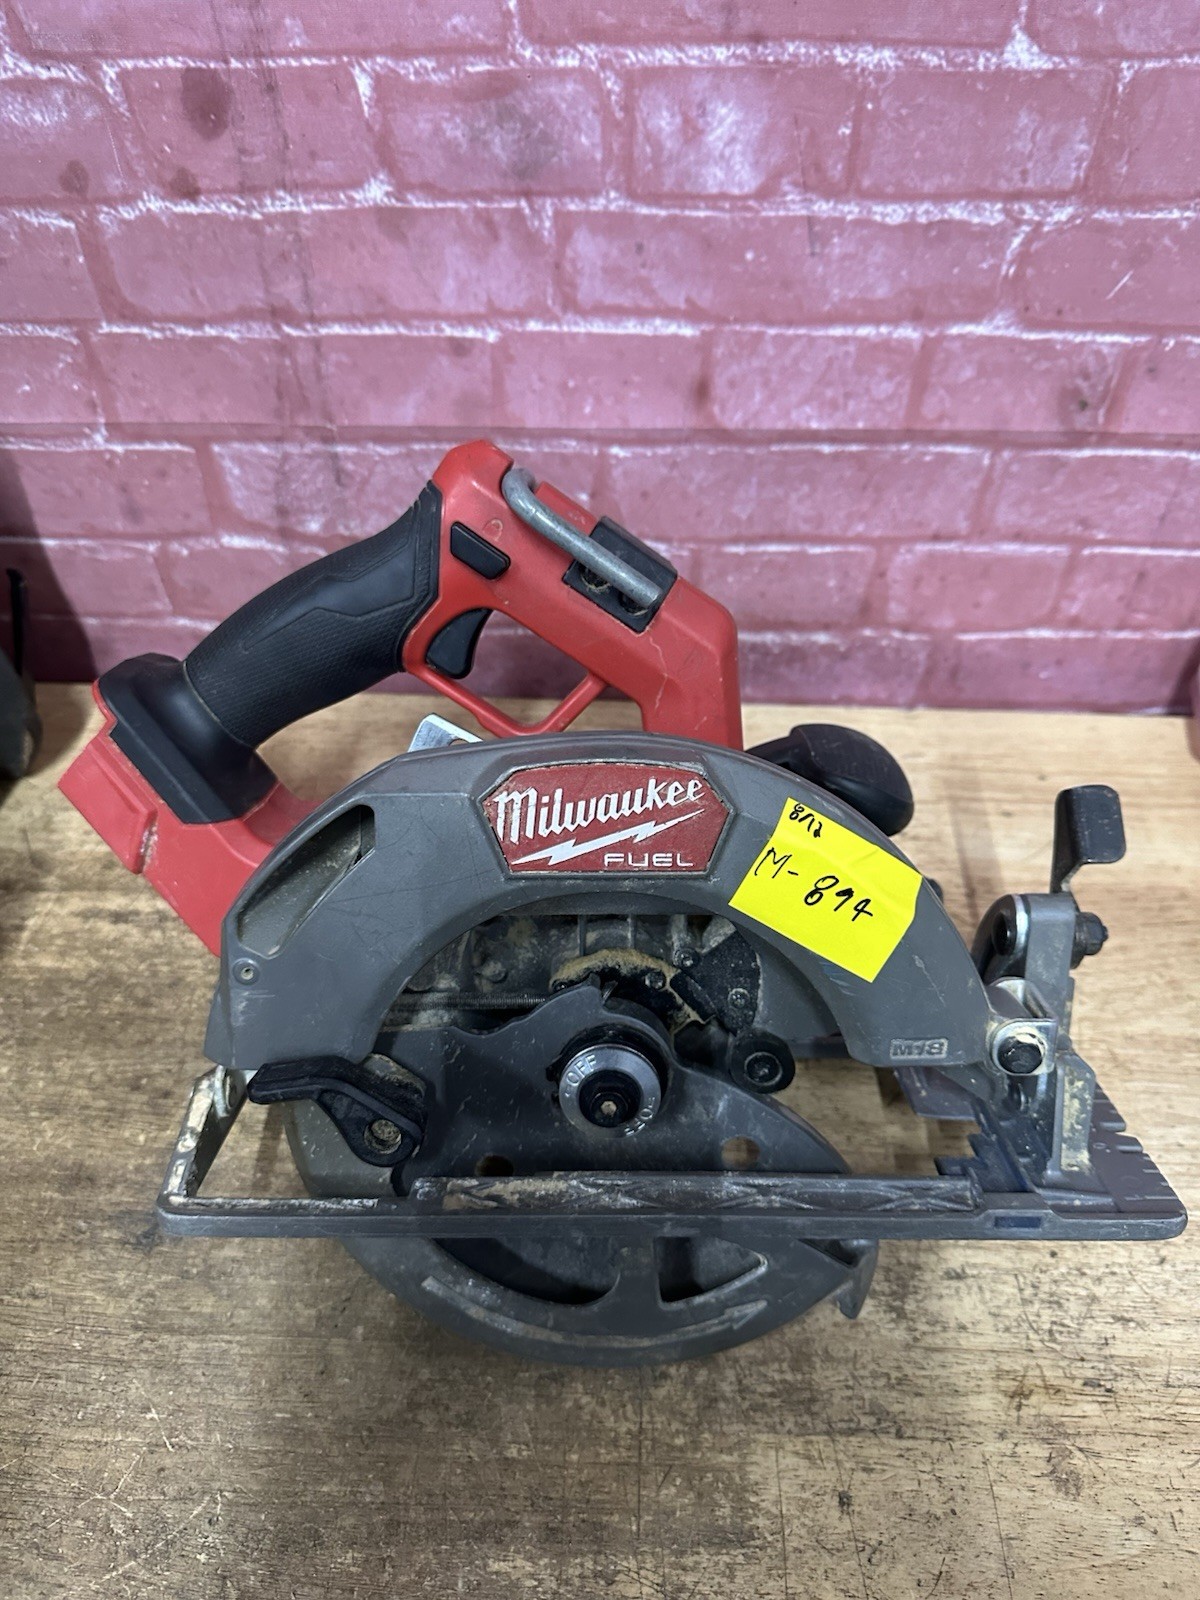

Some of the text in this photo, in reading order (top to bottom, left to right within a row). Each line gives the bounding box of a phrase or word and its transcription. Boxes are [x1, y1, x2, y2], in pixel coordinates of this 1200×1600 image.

[494, 777, 705, 844] Milwaukee
[603, 852, 694, 867] FUEL
[892, 1039, 946, 1057] M18
[566, 1054, 597, 1086] OFF
